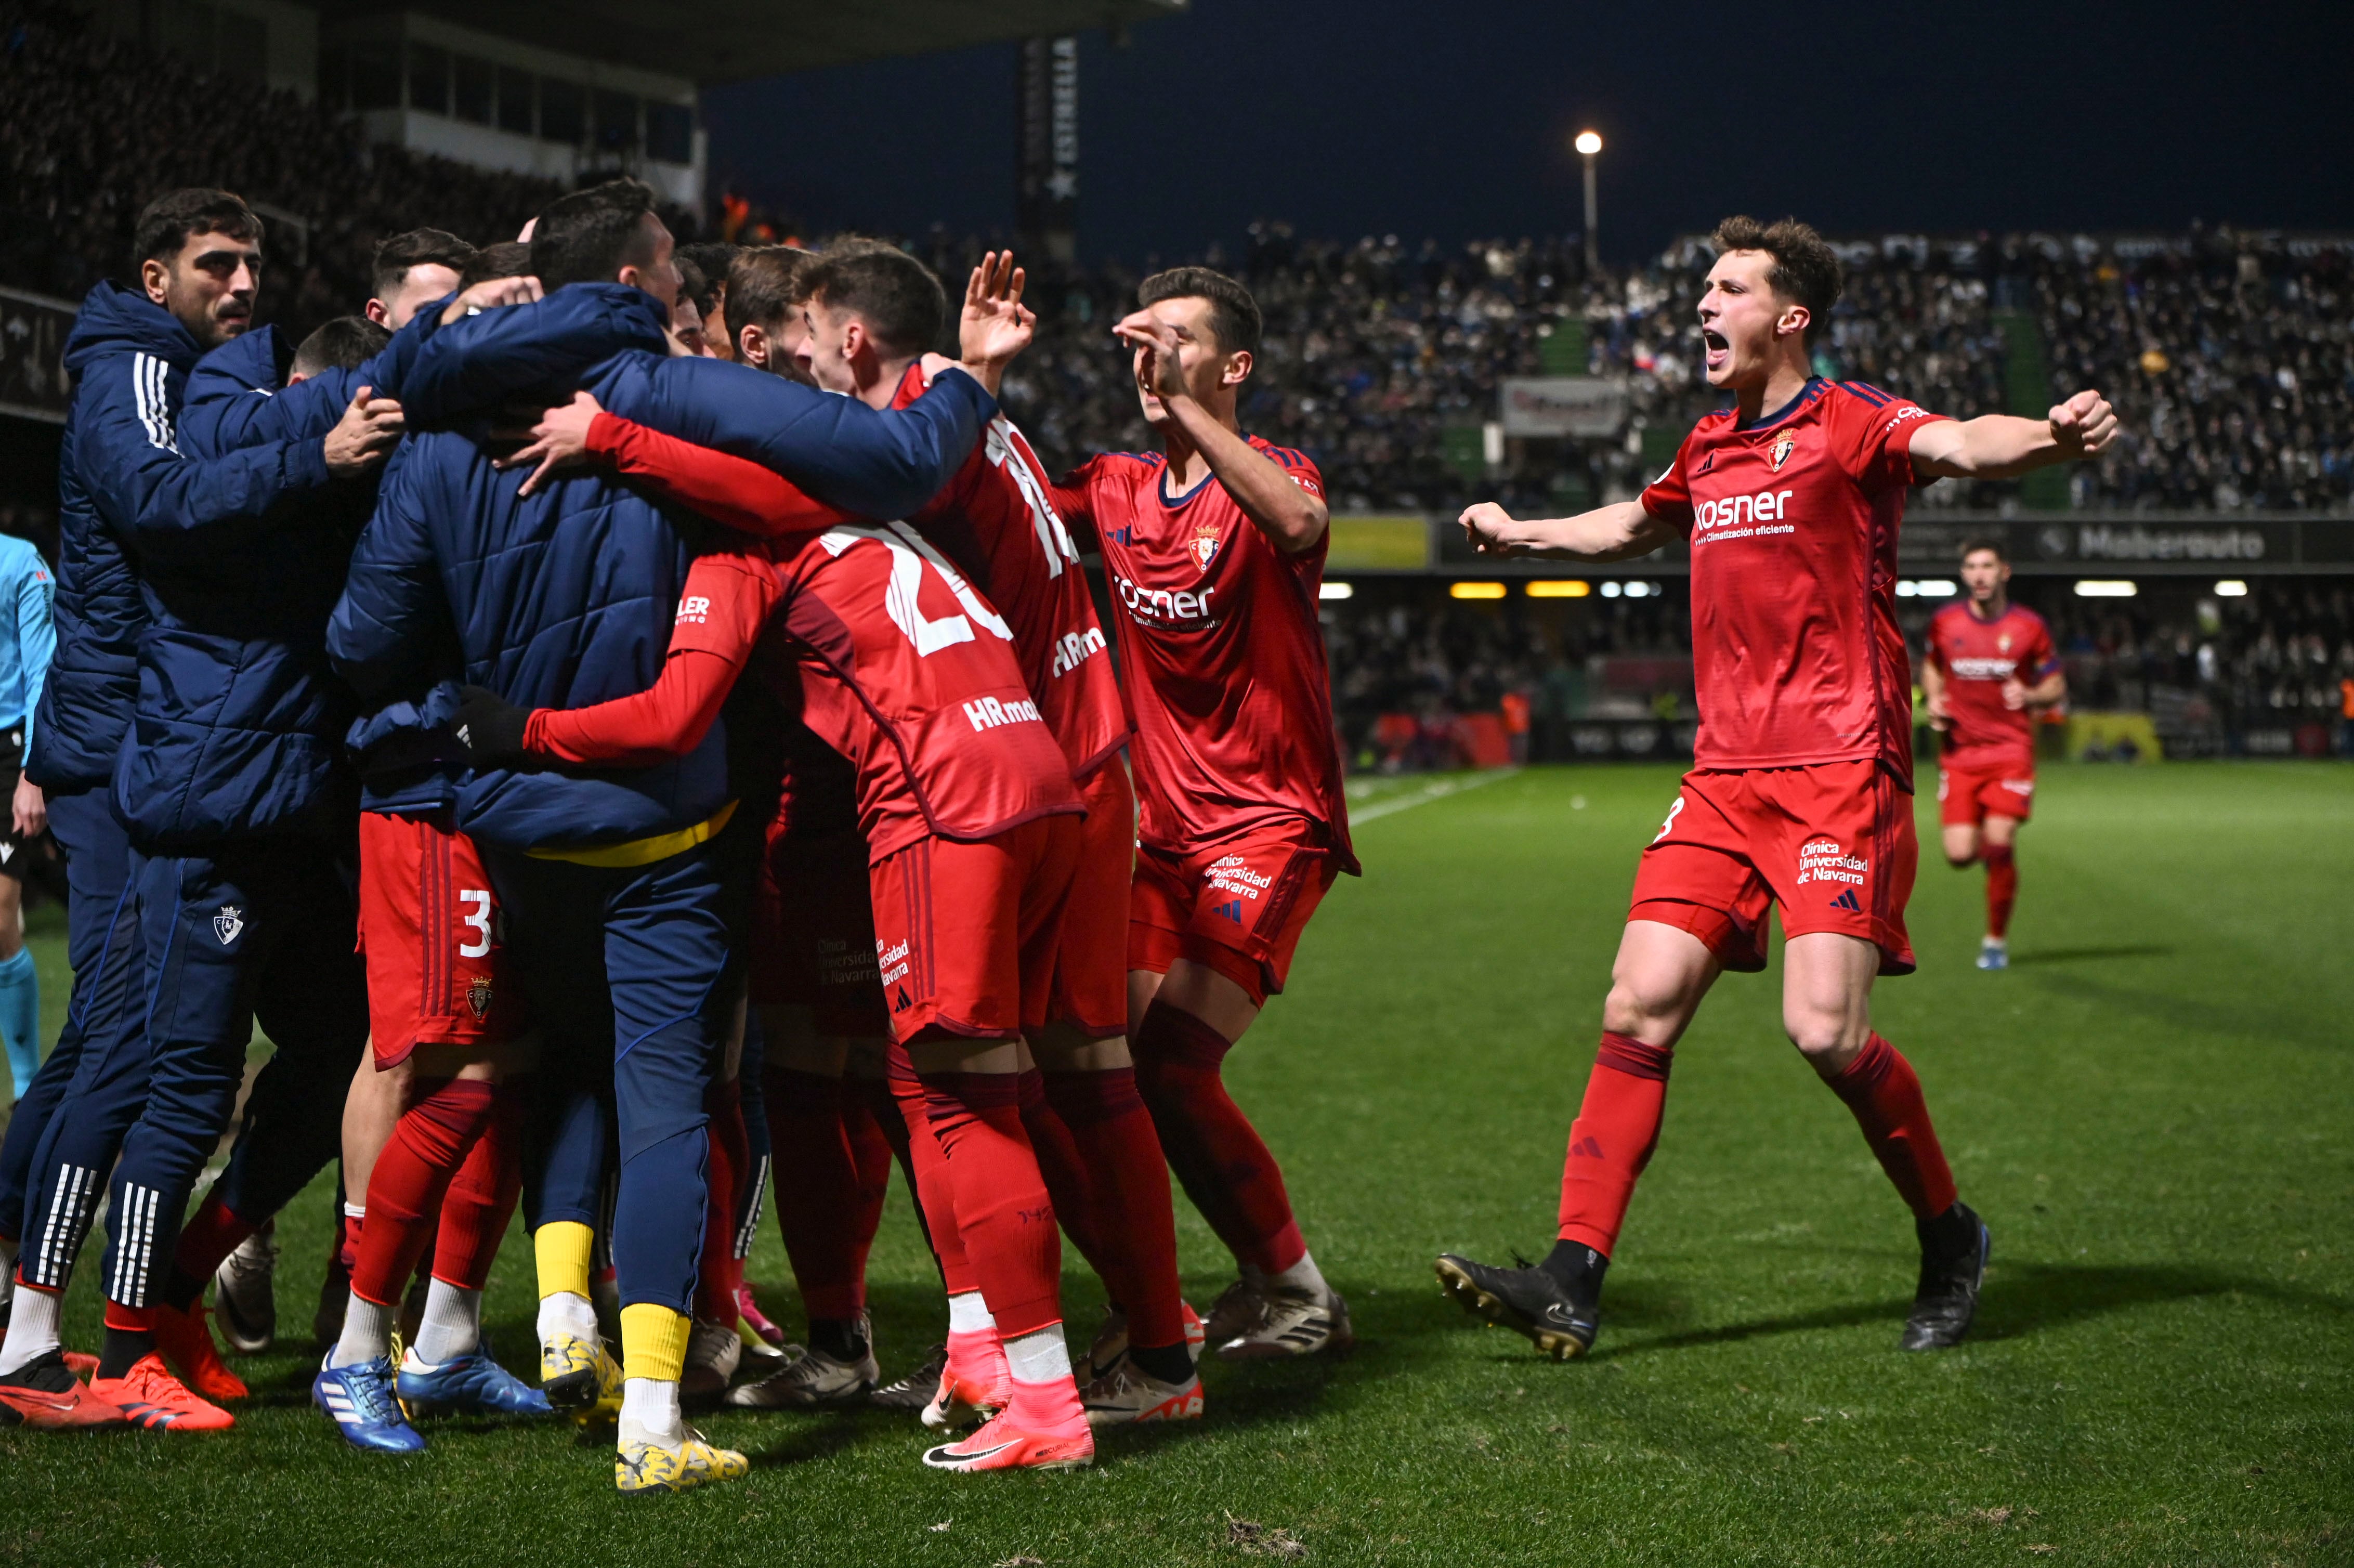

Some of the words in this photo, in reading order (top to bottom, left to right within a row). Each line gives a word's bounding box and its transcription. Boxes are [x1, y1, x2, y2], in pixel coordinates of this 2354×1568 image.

[1707, 527, 1753, 543] Climatización
[1755, 524, 1795, 535] eficiente
[1114, 575, 1214, 619] osner
[1800, 841, 1839, 857] Clínica
[1799, 854, 1868, 872] Universidad
[1797, 871, 1810, 884] de
[1813, 867, 1864, 885] Navarra
[460, 890, 492, 958] 3
